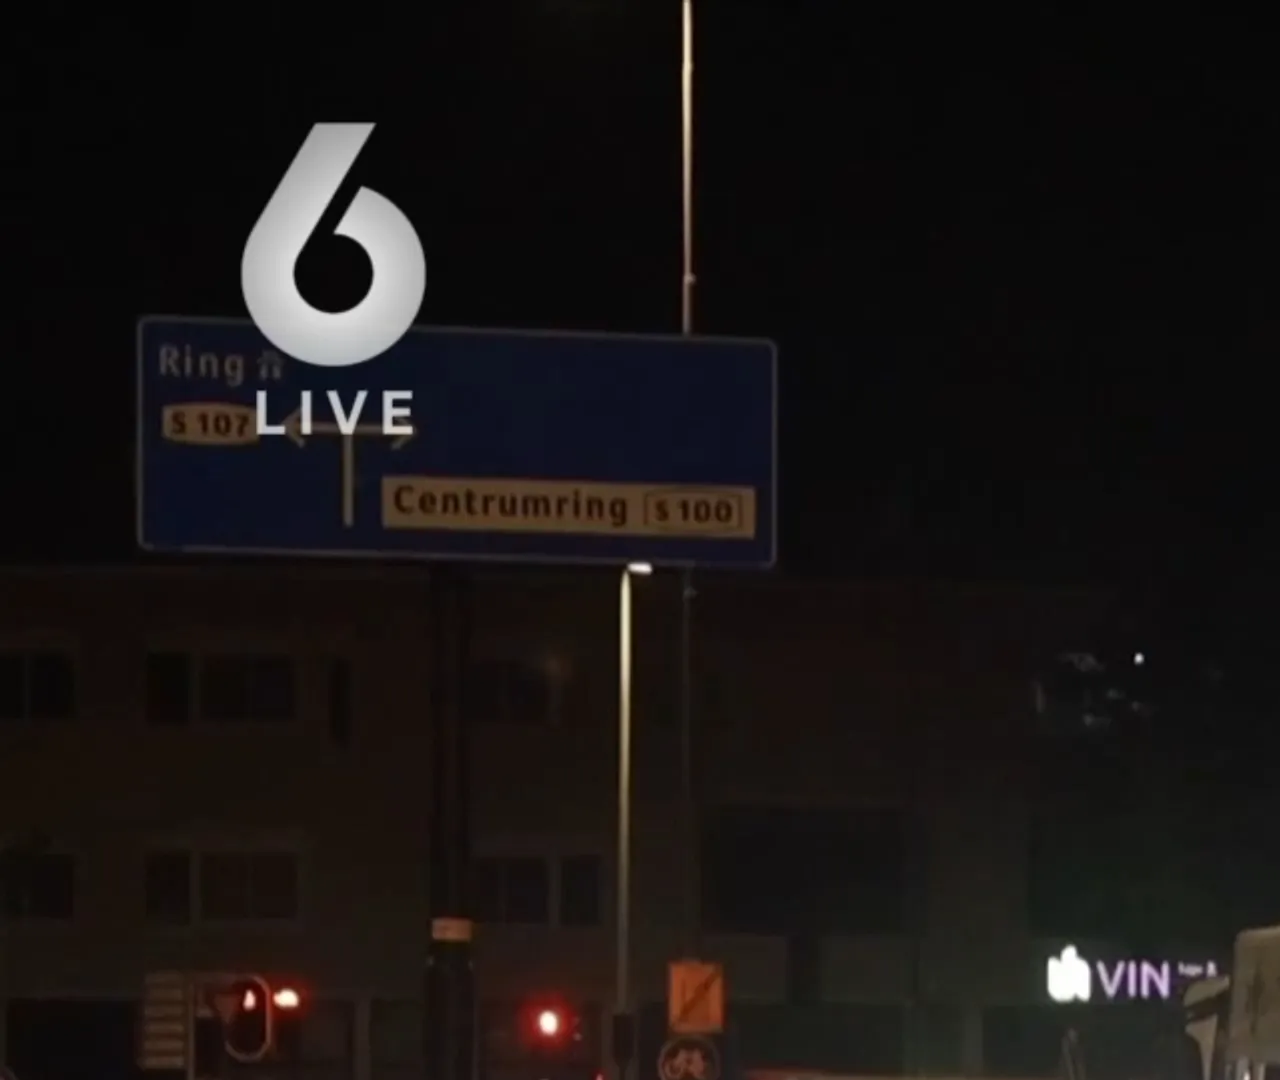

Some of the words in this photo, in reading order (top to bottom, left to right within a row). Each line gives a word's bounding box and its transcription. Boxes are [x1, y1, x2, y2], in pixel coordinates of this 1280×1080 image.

[158, 345, 245, 387] Ring
[171, 409, 187, 435] S
[197, 410, 250, 438] 107
[393, 483, 629, 527] Centrumring
[656, 502, 670, 523] S
[679, 501, 734, 524] 100
[1096, 960, 1171, 999] VIN
